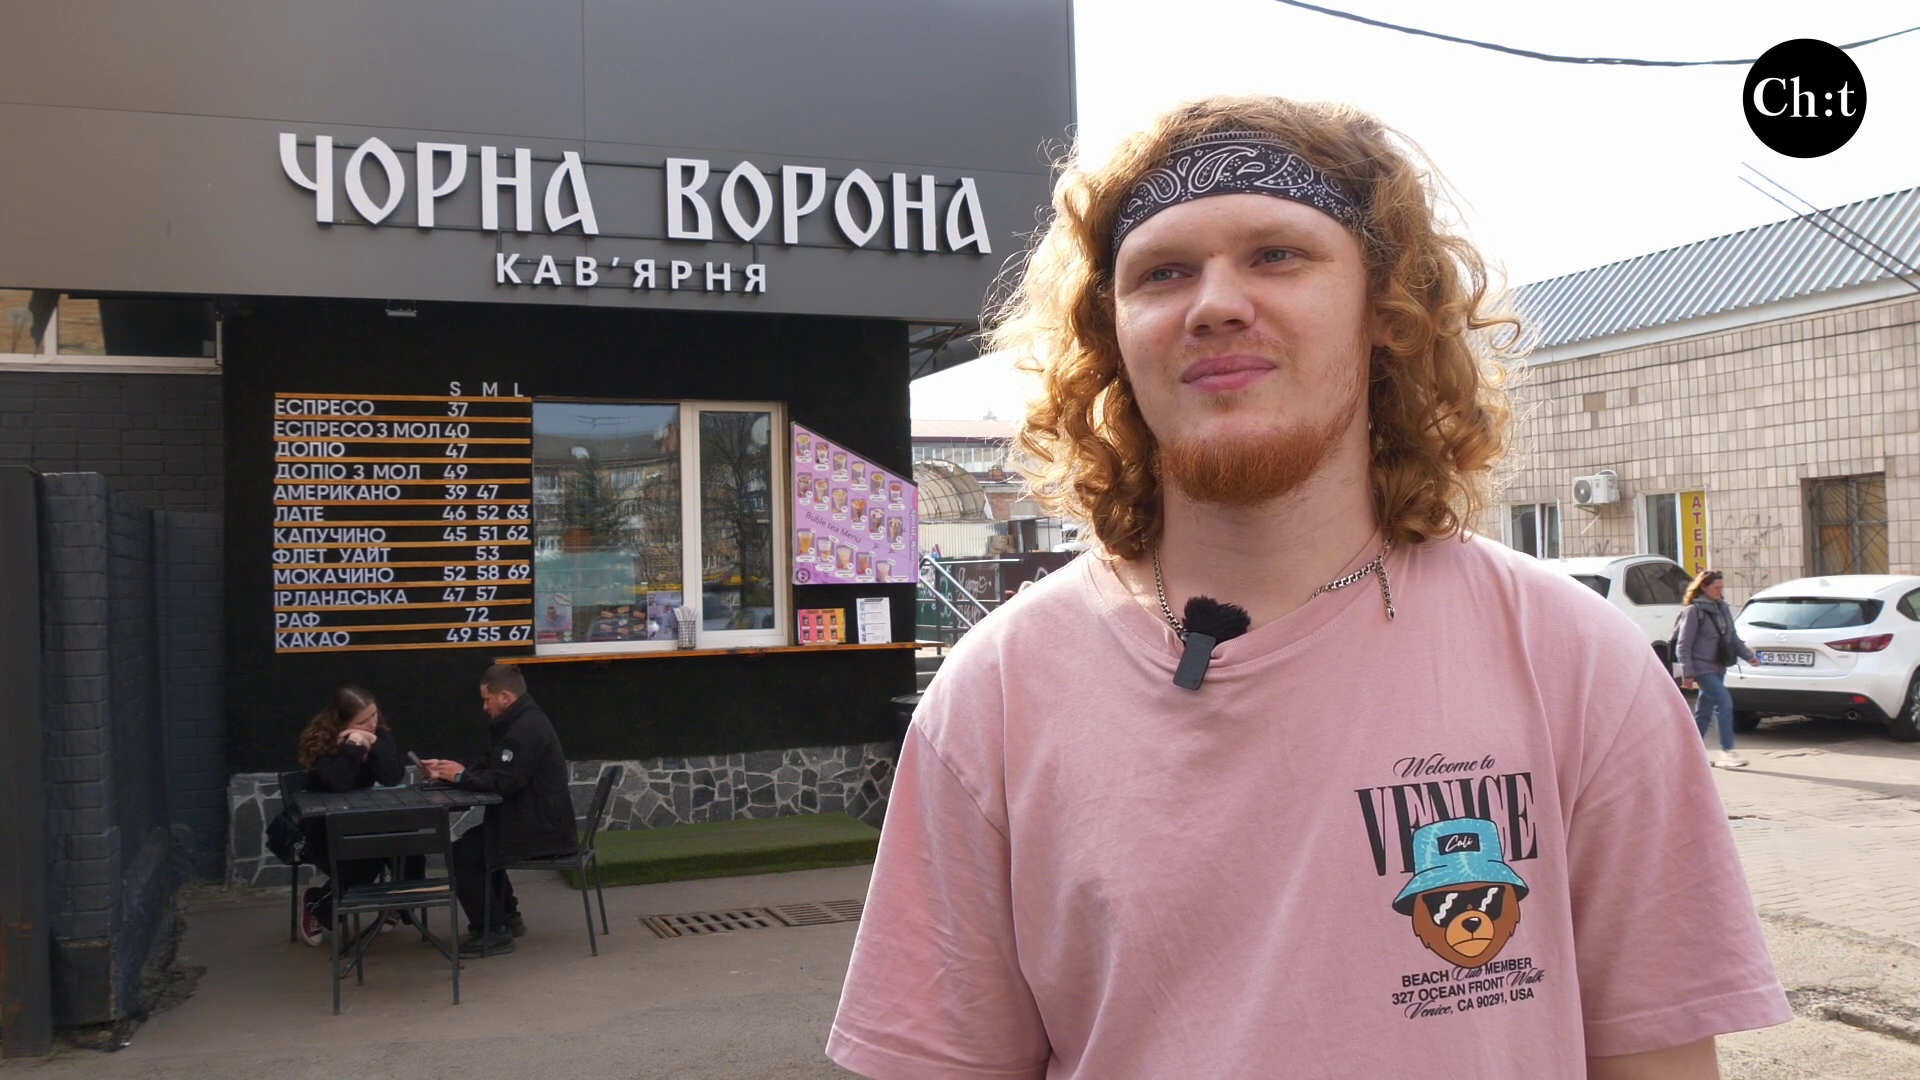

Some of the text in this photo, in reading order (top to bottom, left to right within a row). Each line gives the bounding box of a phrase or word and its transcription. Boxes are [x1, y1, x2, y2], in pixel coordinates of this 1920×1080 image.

[279, 132, 992, 254] ЧОРНА ВОРОНА
[496, 252, 767, 293] КАВ'ЯРНЯ
[449, 382, 523, 397] S M L
[275, 400, 468, 417] ЕСПРЕСО 37
[274, 421, 374, 437] ЕСПРЕСО
[394, 423, 440, 438] МОЛ
[445, 423, 470, 438] 40
[276, 442, 468, 458] ДОПІО 47
[276, 464, 346, 480] ДОПІО
[374, 465, 420, 480] МОЛ
[443, 465, 468, 479] 49
[274, 485, 499, 501] АМЕРИКАНО 39 47
[274, 505, 528, 521] ЛАТЕ 46 52 63
[274, 526, 528, 544] КАПУЧИНО 45 51 62
[805, 512, 827, 527] Buble
[827, 522, 839, 533] tea
[840, 529, 862, 543] Menu
[272, 547, 500, 564] ФЛЕТ УАЙТ 53
[275, 565, 530, 584] МОКАЧИНО 52 58 69
[275, 587, 498, 606] ІРЛАНДСЬКА 47 57
[276, 607, 489, 628] РАФ 72
[276, 626, 531, 648] КАКАО 49 55 67
[1763, 653, 1811, 663] CB 1053 ET
[1393, 753, 1495, 778] Welcome to
[1445, 835, 1473, 852] Cali
[1402, 970, 1449, 987] BEACH
[1485, 957, 1532, 975] MEMBER
[1392, 968, 1545, 1005] 327 OCEAN FRONT Walk
[1404, 988, 1534, 1019] Venice, CA 90291, USA
